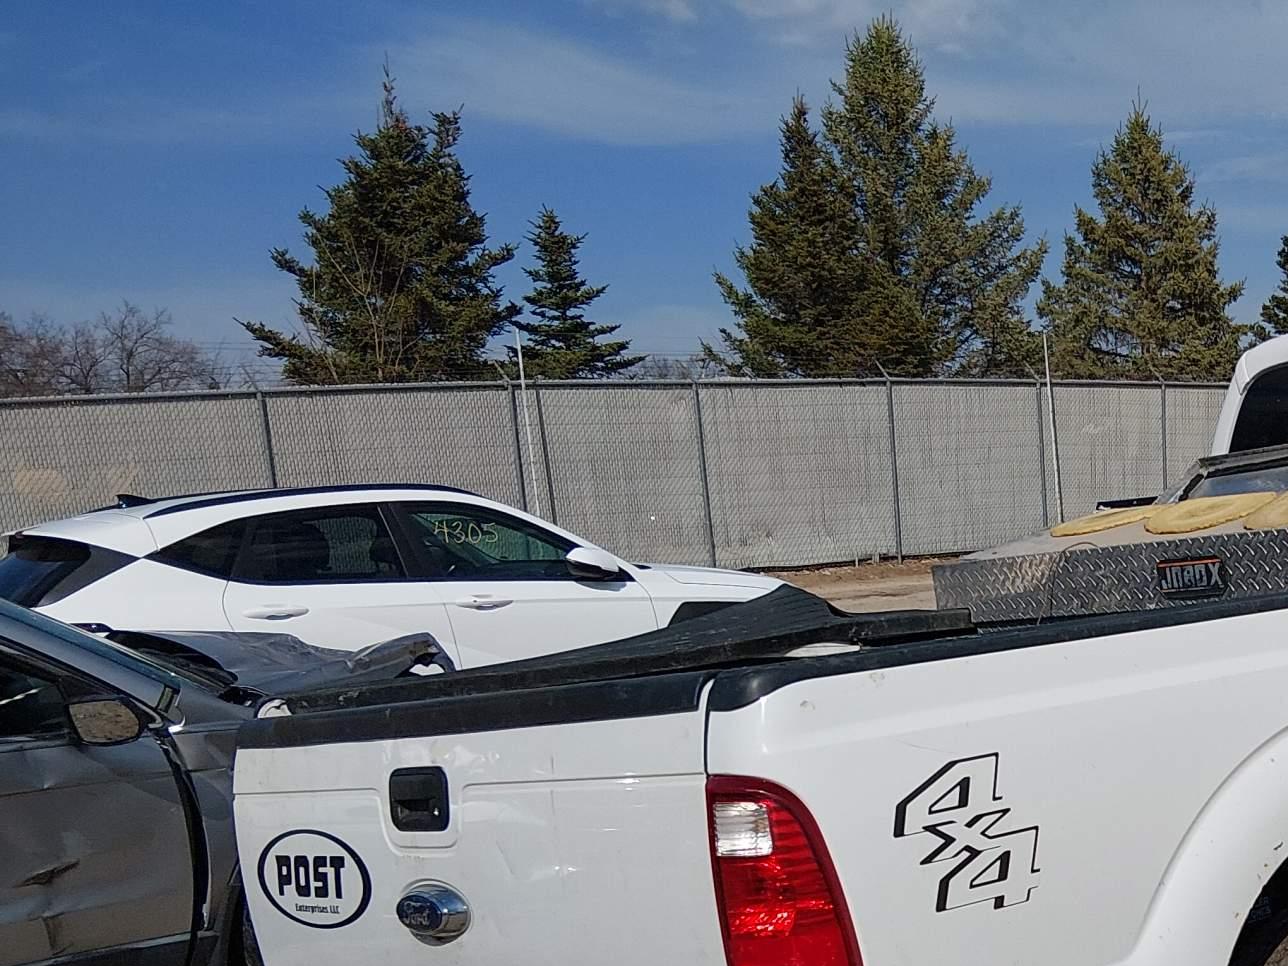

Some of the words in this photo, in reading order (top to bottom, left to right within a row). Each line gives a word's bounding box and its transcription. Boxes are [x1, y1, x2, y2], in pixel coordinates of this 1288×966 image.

[432, 520, 498, 543] 4305
[275, 855, 345, 899] POST
[295, 903, 329, 915] Enterprises
[329, 904, 340, 915] LLC
[402, 900, 432, 926] Ford
